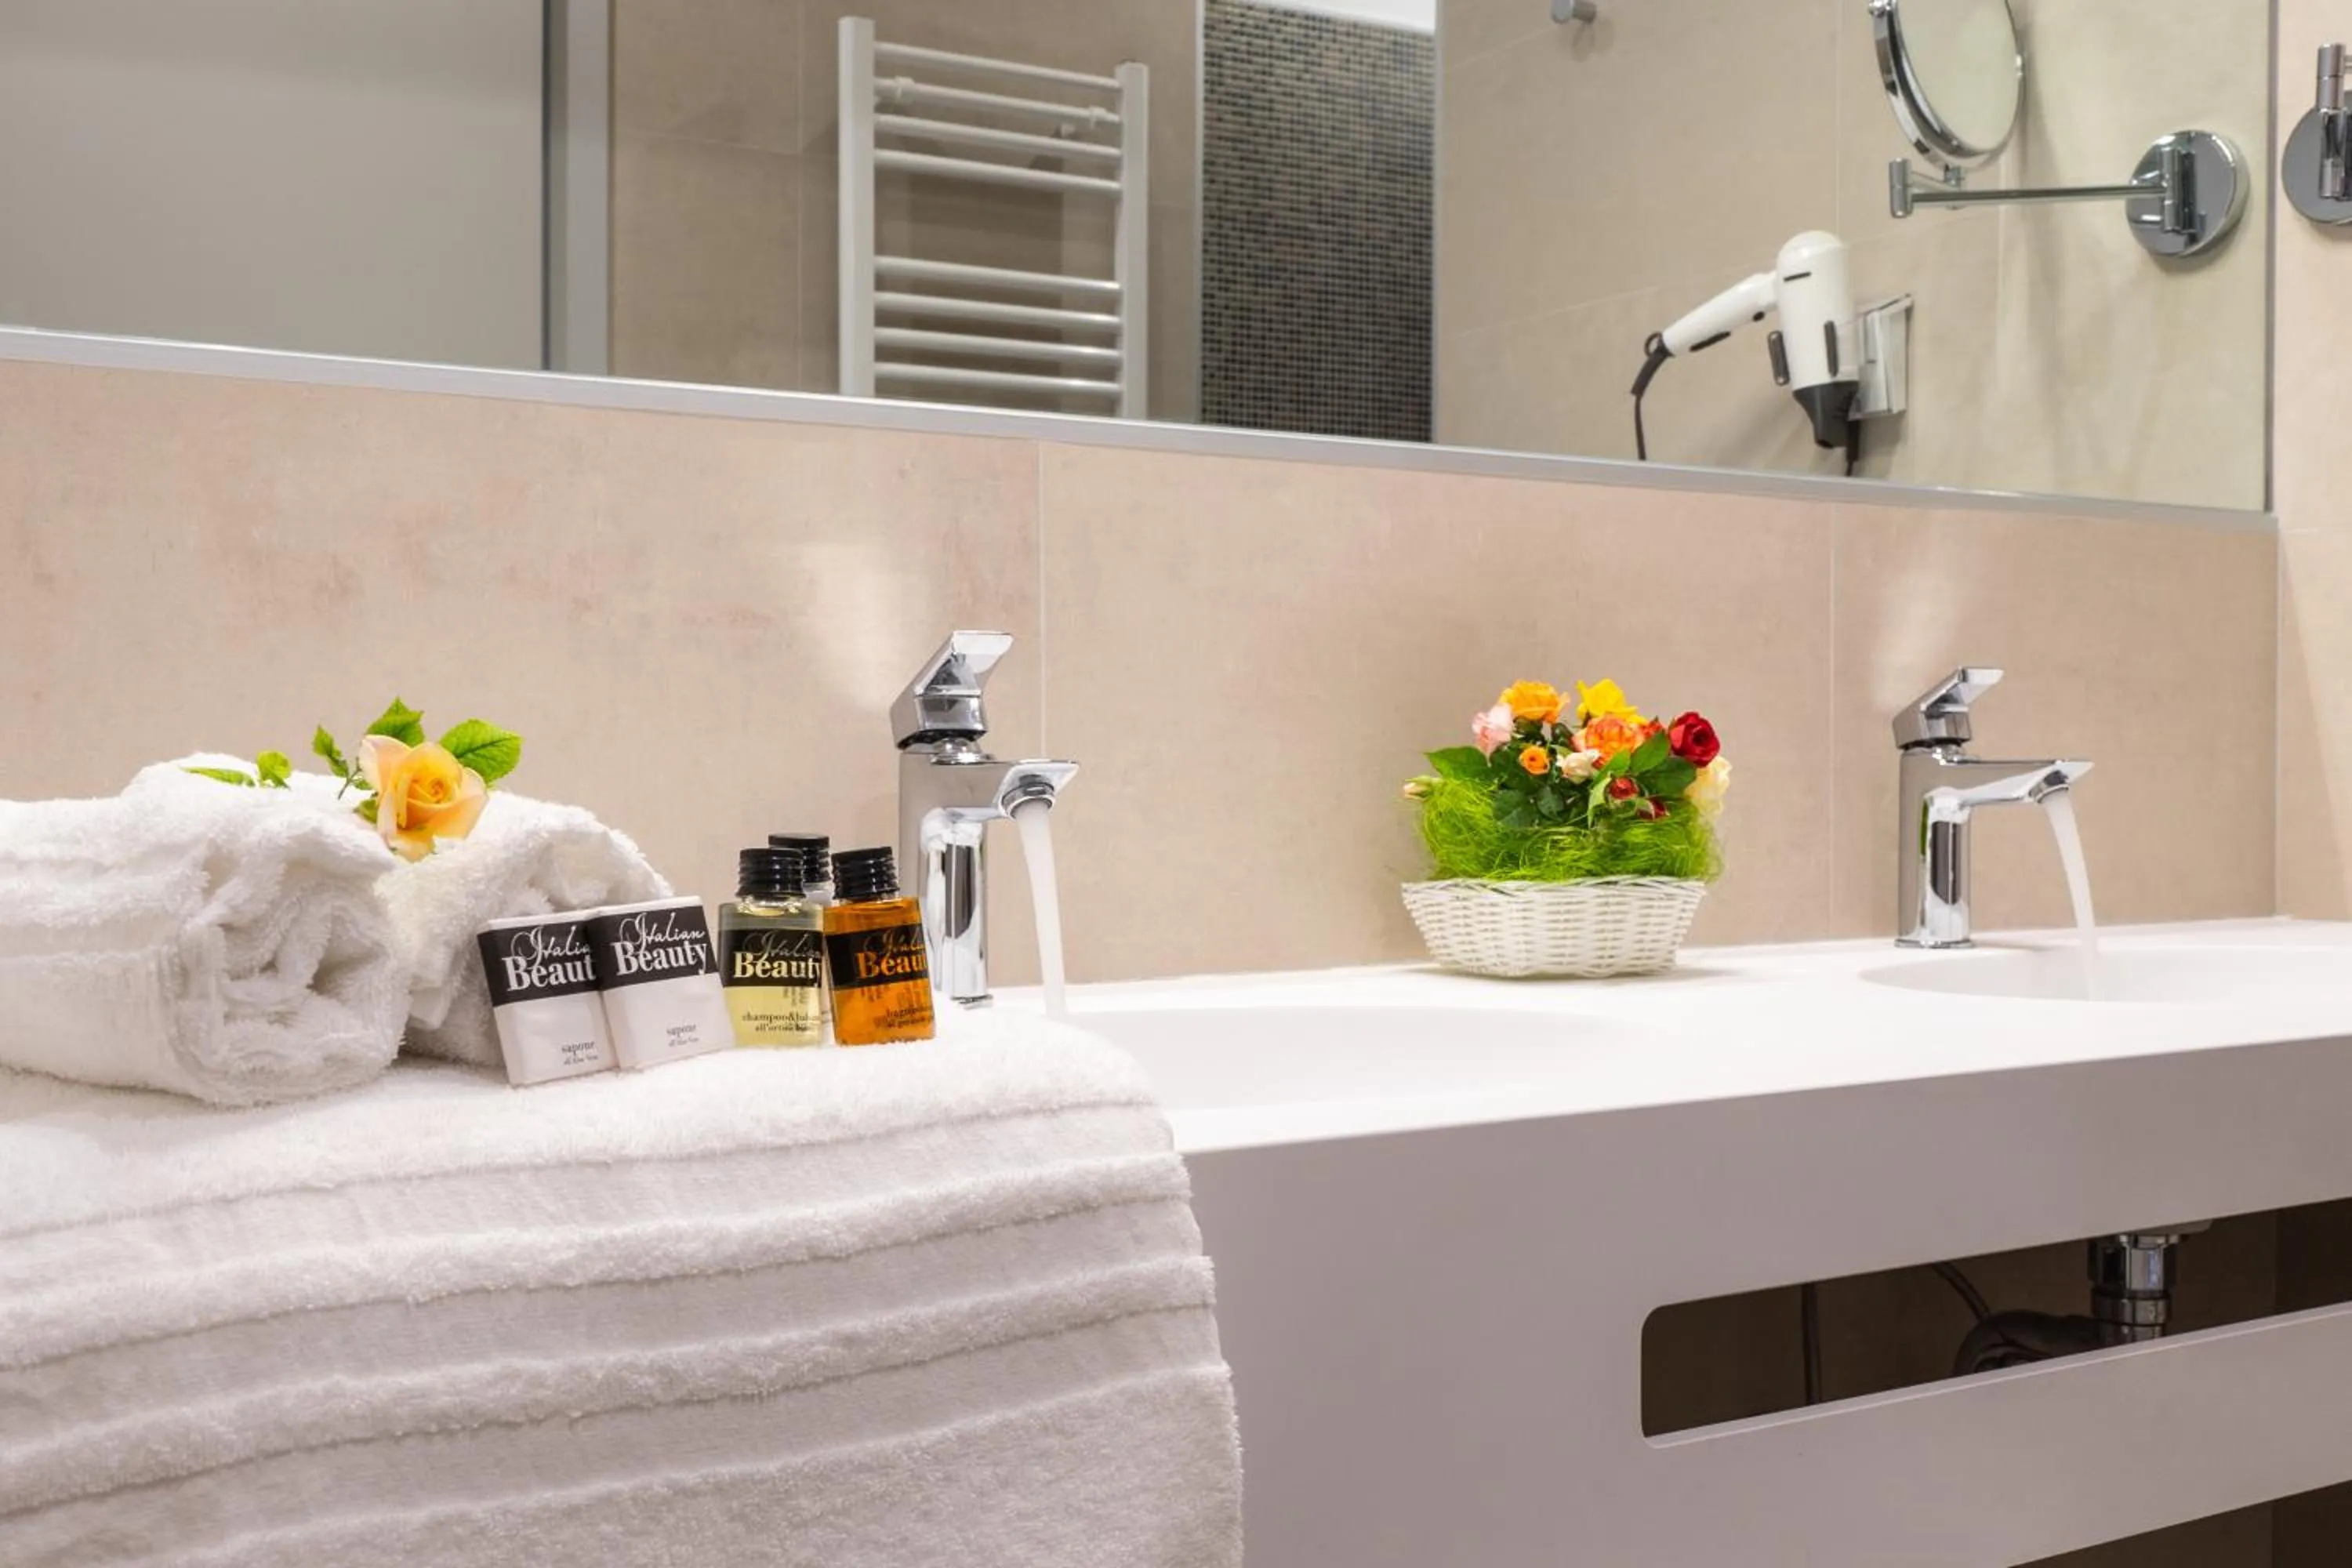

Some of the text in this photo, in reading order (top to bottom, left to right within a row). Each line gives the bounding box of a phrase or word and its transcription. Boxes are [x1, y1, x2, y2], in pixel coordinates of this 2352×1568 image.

[511, 925, 591, 966] Italia
[620, 912, 706, 952] Italian
[502, 954, 597, 991] Beaut
[609, 941, 707, 975] Beauty
[733, 951, 822, 988] Beauty
